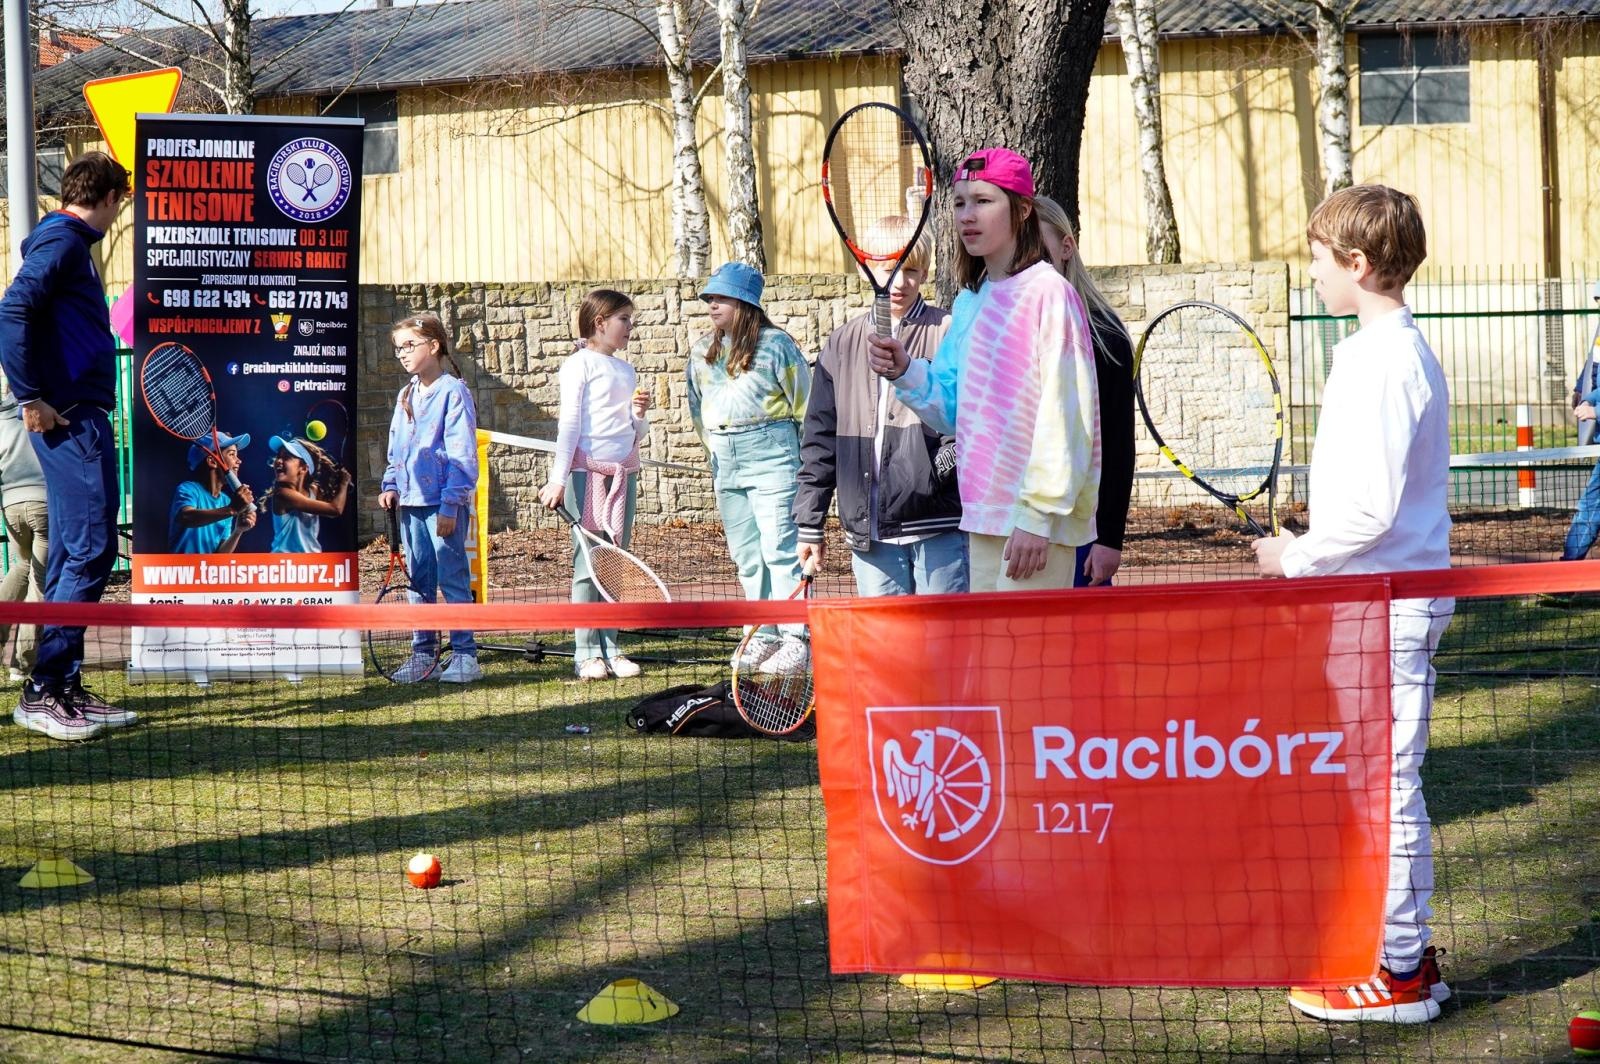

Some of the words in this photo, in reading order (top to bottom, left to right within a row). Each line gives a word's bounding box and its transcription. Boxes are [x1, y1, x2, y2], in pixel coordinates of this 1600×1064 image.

[147, 138, 255, 159] PROFESJONALNE
[146, 160, 255, 190] SZKOLENIE
[270, 142, 300, 191] RACIBORSKI
[301, 140, 326, 150] KLUB
[326, 145, 350, 192] TENISOWY
[145, 191, 255, 222] TENISOWE
[298, 211, 322, 220] 2018
[146, 226, 231, 246] PRZEDSZKOLE
[233, 228, 297, 247] TENISOWE
[299, 229, 317, 247] OD
[318, 229, 327, 247] 3
[329, 229, 349, 248] LAT
[146, 249, 251, 268] SPECJALISTYCZNY
[254, 251, 303, 269] SERWIS
[305, 252, 348, 269] RAKIET
[201, 274, 248, 286] ZAPRASZAMY
[249, 275, 259, 286] DO
[260, 275, 297, 287] KONTAKTU
[163, 289, 190, 308] 698
[193, 290, 221, 308] 622
[223, 290, 251, 308] 434
[268, 291, 296, 309] 662
[298, 291, 323, 309] 773
[324, 292, 348, 310] 743
[148, 315, 251, 334] WSPÓŁPRACUJEMY
[254, 318, 261, 334] Z
[316, 321, 348, 329] Racibórz
[293, 343, 321, 356] ZNAJDŹ
[321, 345, 336, 357] NAS
[337, 345, 347, 357] NA
[243, 362, 347, 376] @raciborskiklubtenisowy
[294, 379, 347, 392] @rktraciborz
[142, 559, 351, 588] www.tenisraciborz.pl
[1032, 718, 1347, 780] Racibórz
[1032, 802, 1114, 843] 1217
